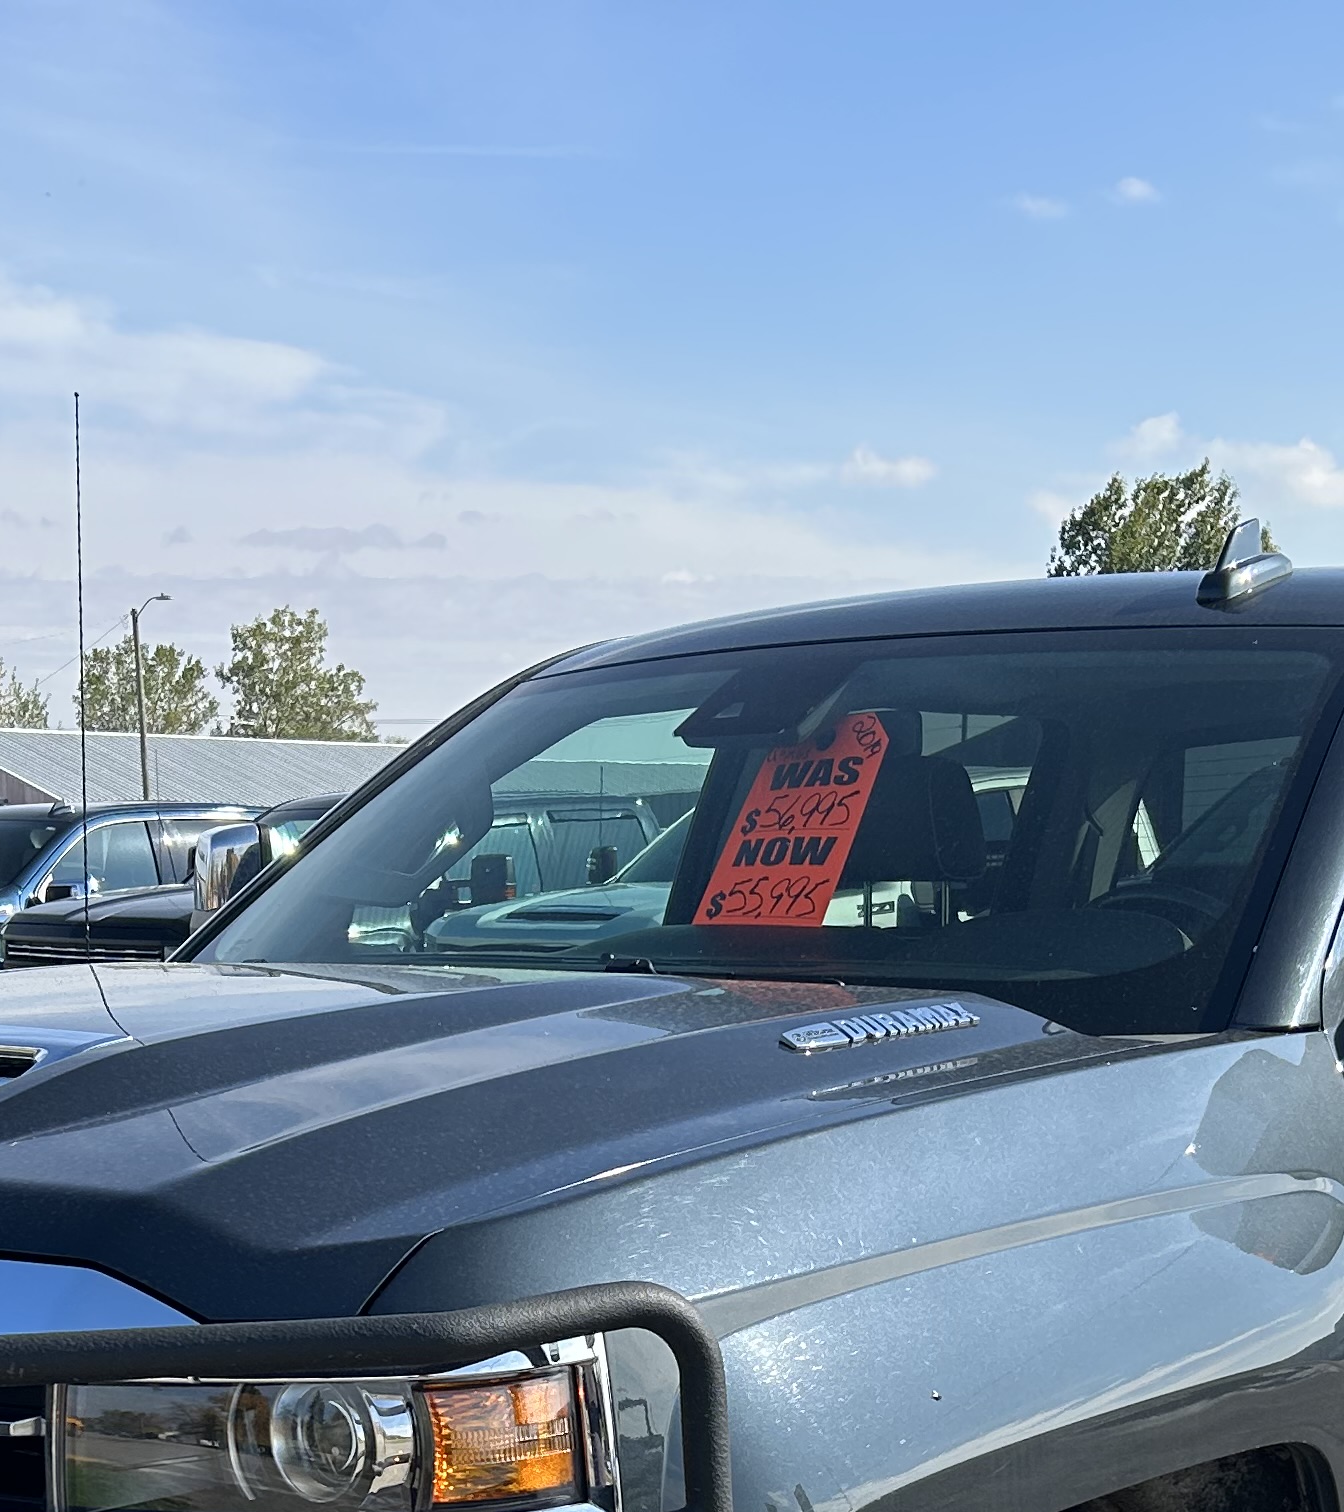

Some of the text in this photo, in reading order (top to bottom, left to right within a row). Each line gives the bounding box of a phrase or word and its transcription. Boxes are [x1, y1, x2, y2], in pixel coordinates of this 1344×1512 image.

[770, 756, 864, 791] WAS
[732, 836, 838, 867] NOW
[836, 1001, 981, 1048] DURAMAX
